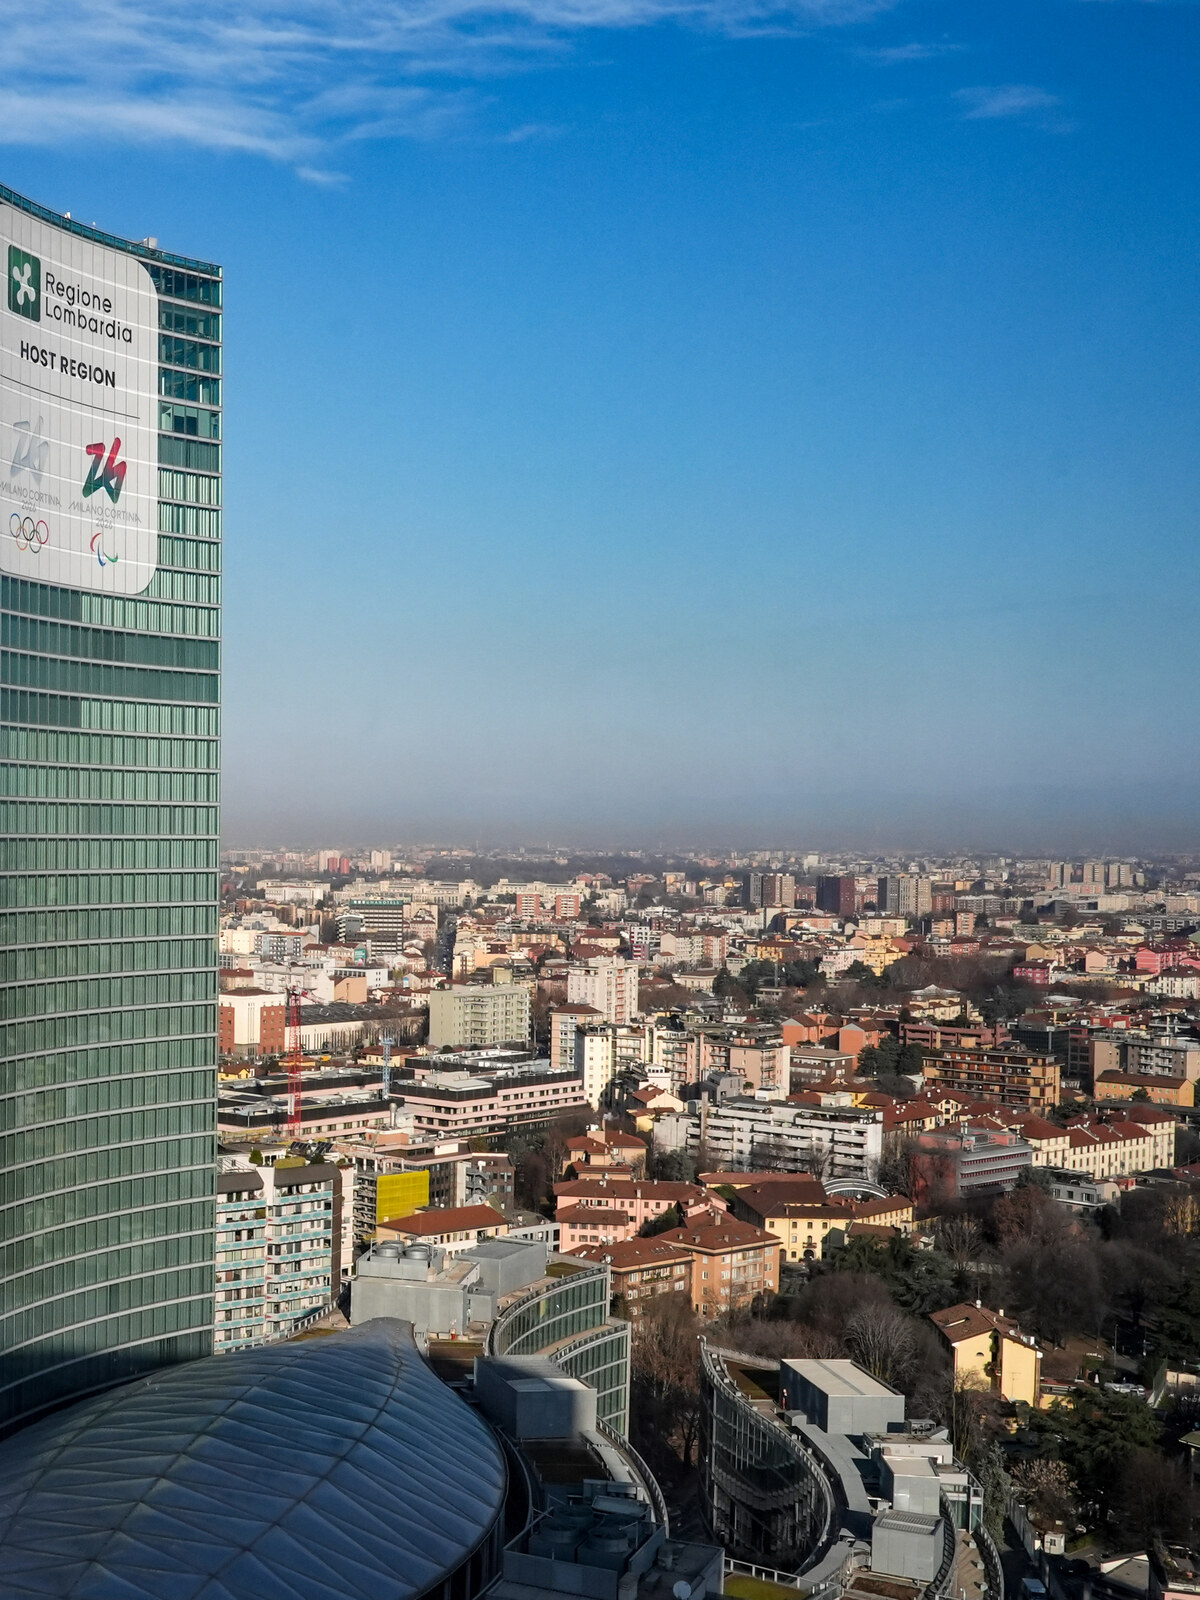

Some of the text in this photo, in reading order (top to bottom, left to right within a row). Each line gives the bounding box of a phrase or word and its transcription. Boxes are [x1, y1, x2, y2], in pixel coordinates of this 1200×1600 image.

[46, 271, 113, 313] Regione
[45, 297, 133, 344] Lombardia
[20, 340, 116, 388] HOST REGION
[29, 489, 62, 508] CORTINA
[68, 500, 142, 523] MILANO CORTINA
